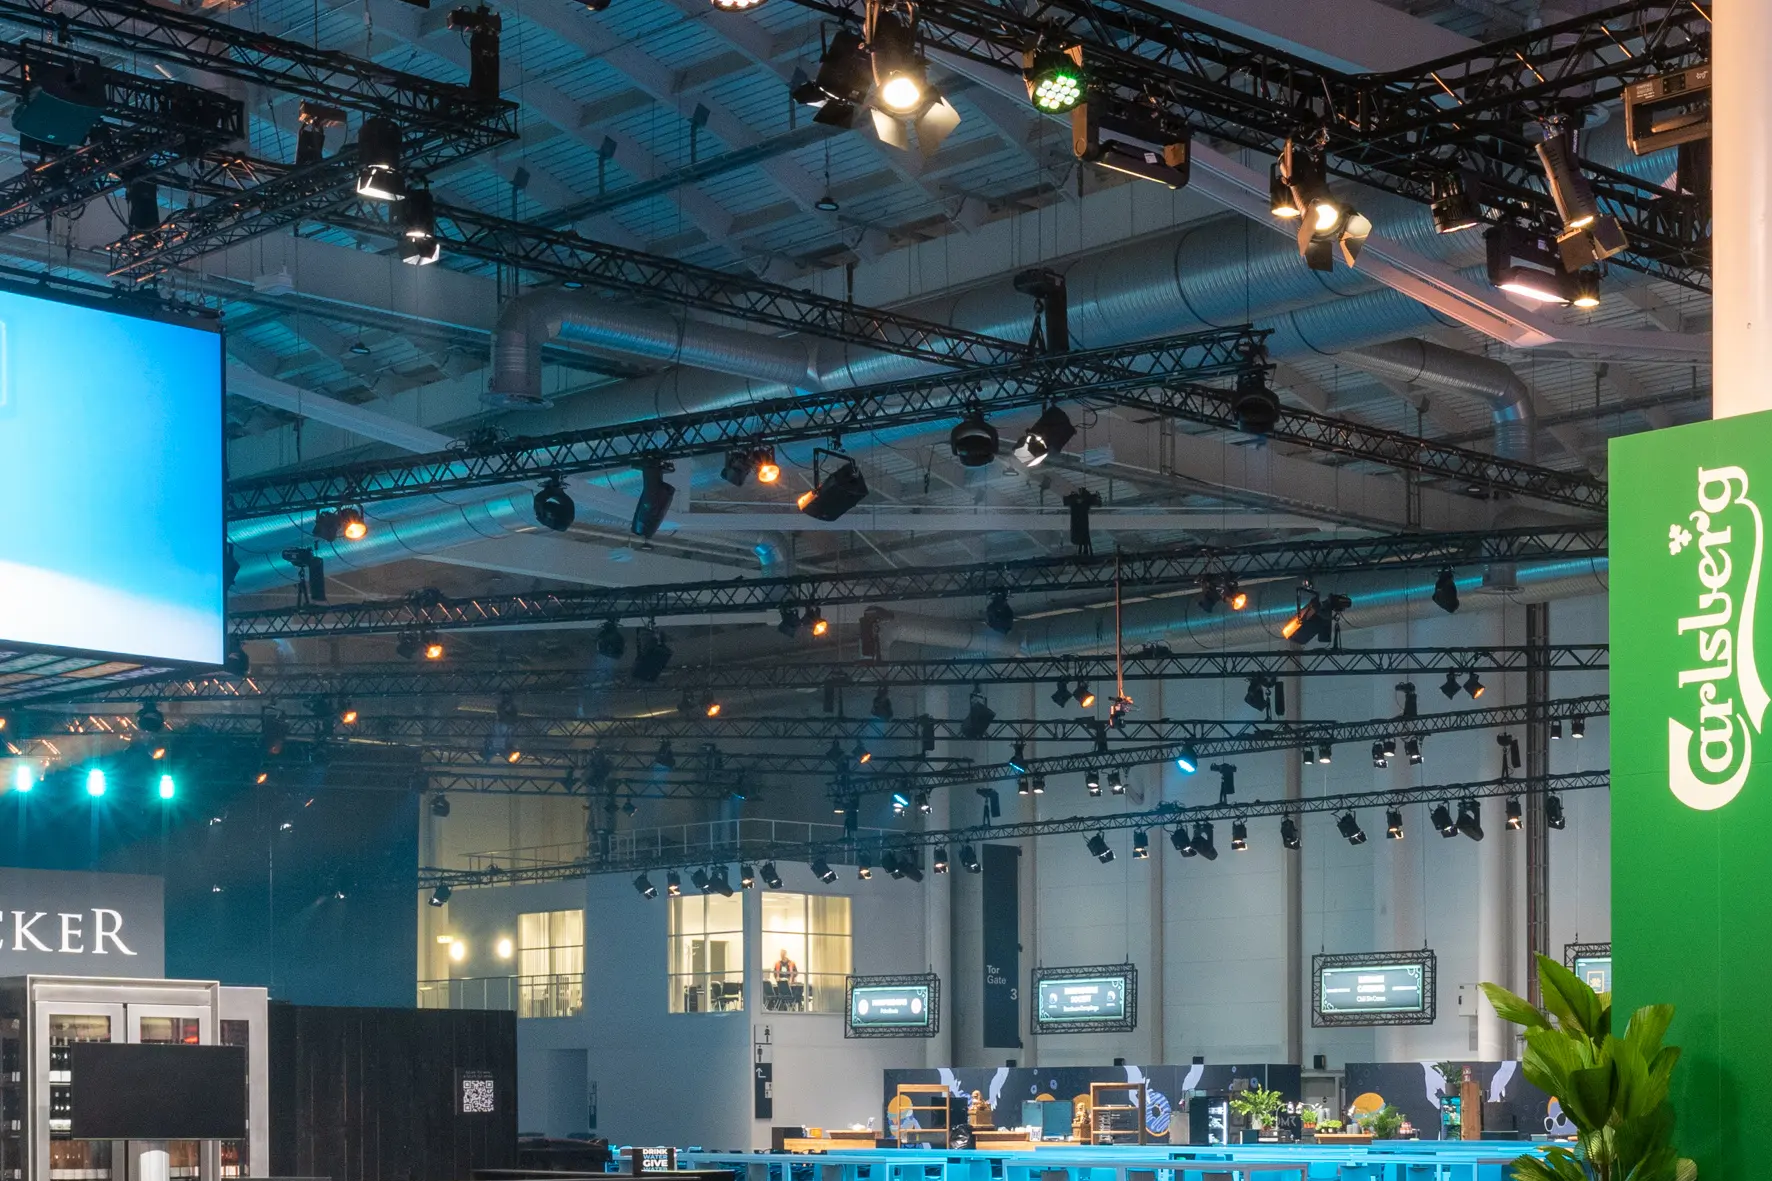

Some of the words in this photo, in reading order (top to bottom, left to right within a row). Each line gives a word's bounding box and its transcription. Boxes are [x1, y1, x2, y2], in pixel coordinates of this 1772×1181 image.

[1669, 465, 1764, 811] Carlsberg
[0, 907, 138, 956] KER
[986, 964, 1000, 974] Tor
[987, 975, 1007, 985] Gate
[1010, 989, 1018, 1000] 3
[642, 1159, 669, 1167] GIVE
